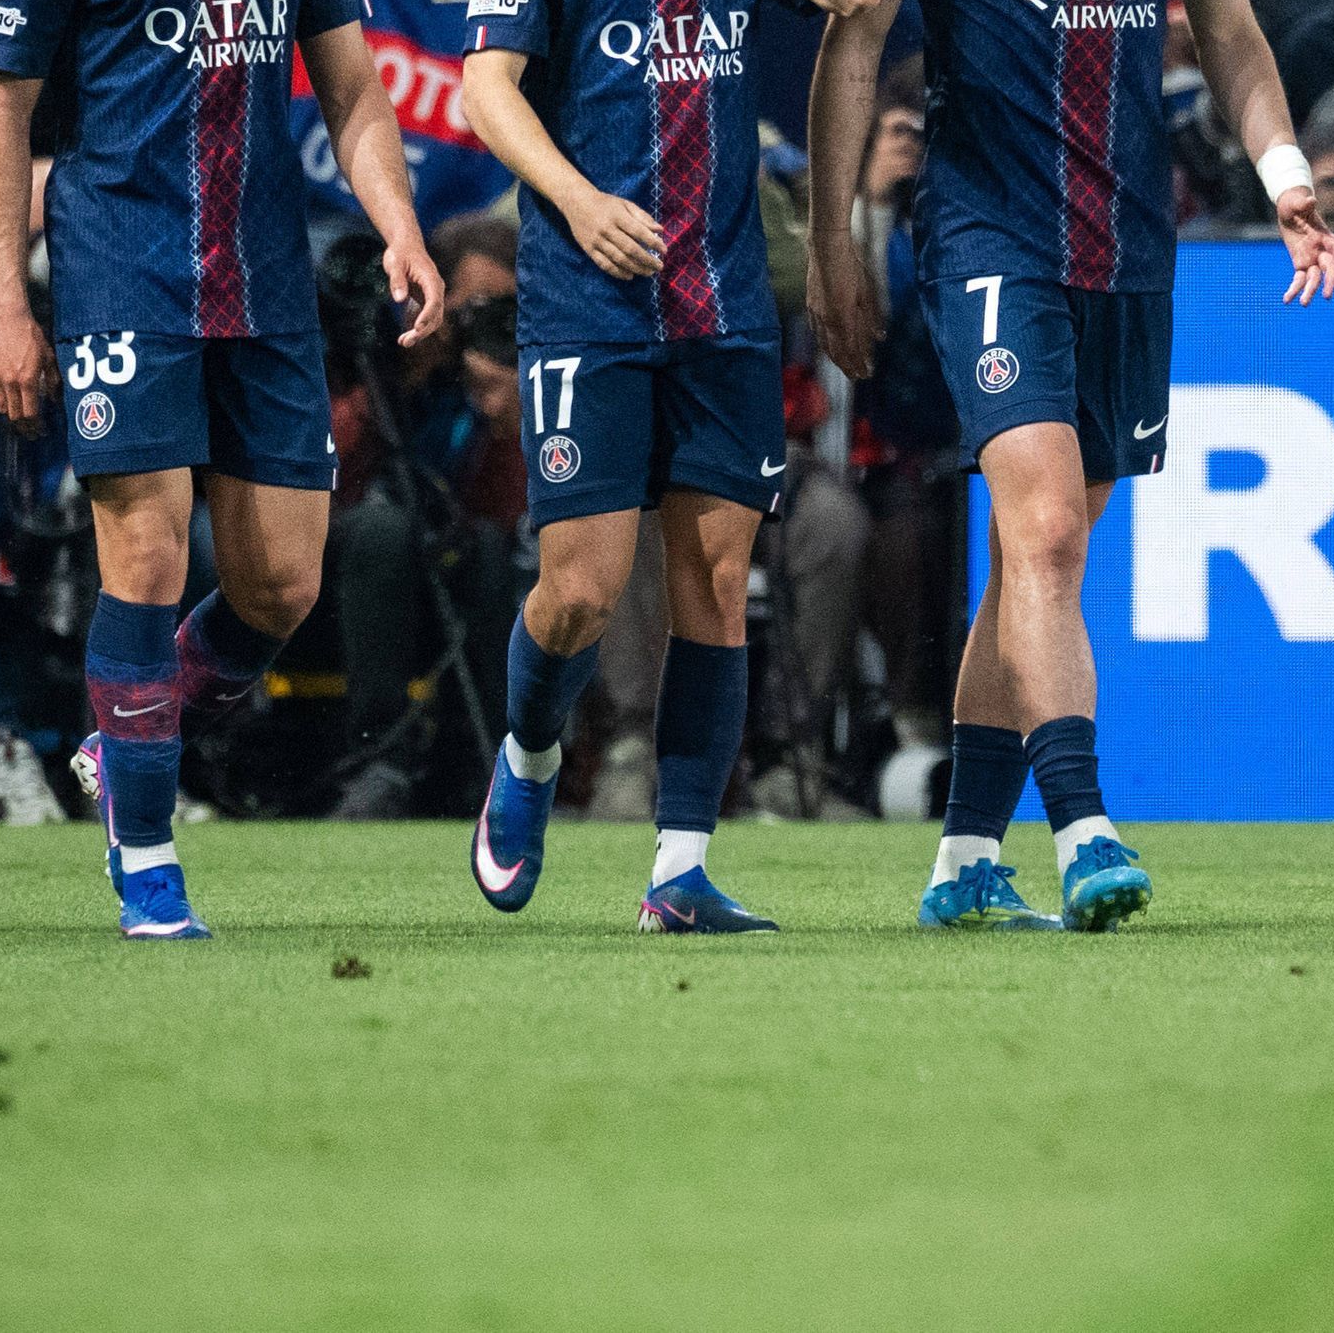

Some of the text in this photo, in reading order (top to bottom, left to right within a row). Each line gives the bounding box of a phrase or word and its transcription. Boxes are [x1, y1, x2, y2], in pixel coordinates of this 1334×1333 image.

[1051, 2, 1156, 30] AIRWAYS
[599, 10, 749, 67] QATAR
[643, 51, 744, 84] AIRWAYS
[966, 274, 1003, 346] 7
[68, 330, 137, 390] 33
[979, 350, 1008, 366] PARIS
[81, 394, 107, 408] PARIS
[528, 356, 582, 435] 17
[543, 438, 571, 452] PARIS
